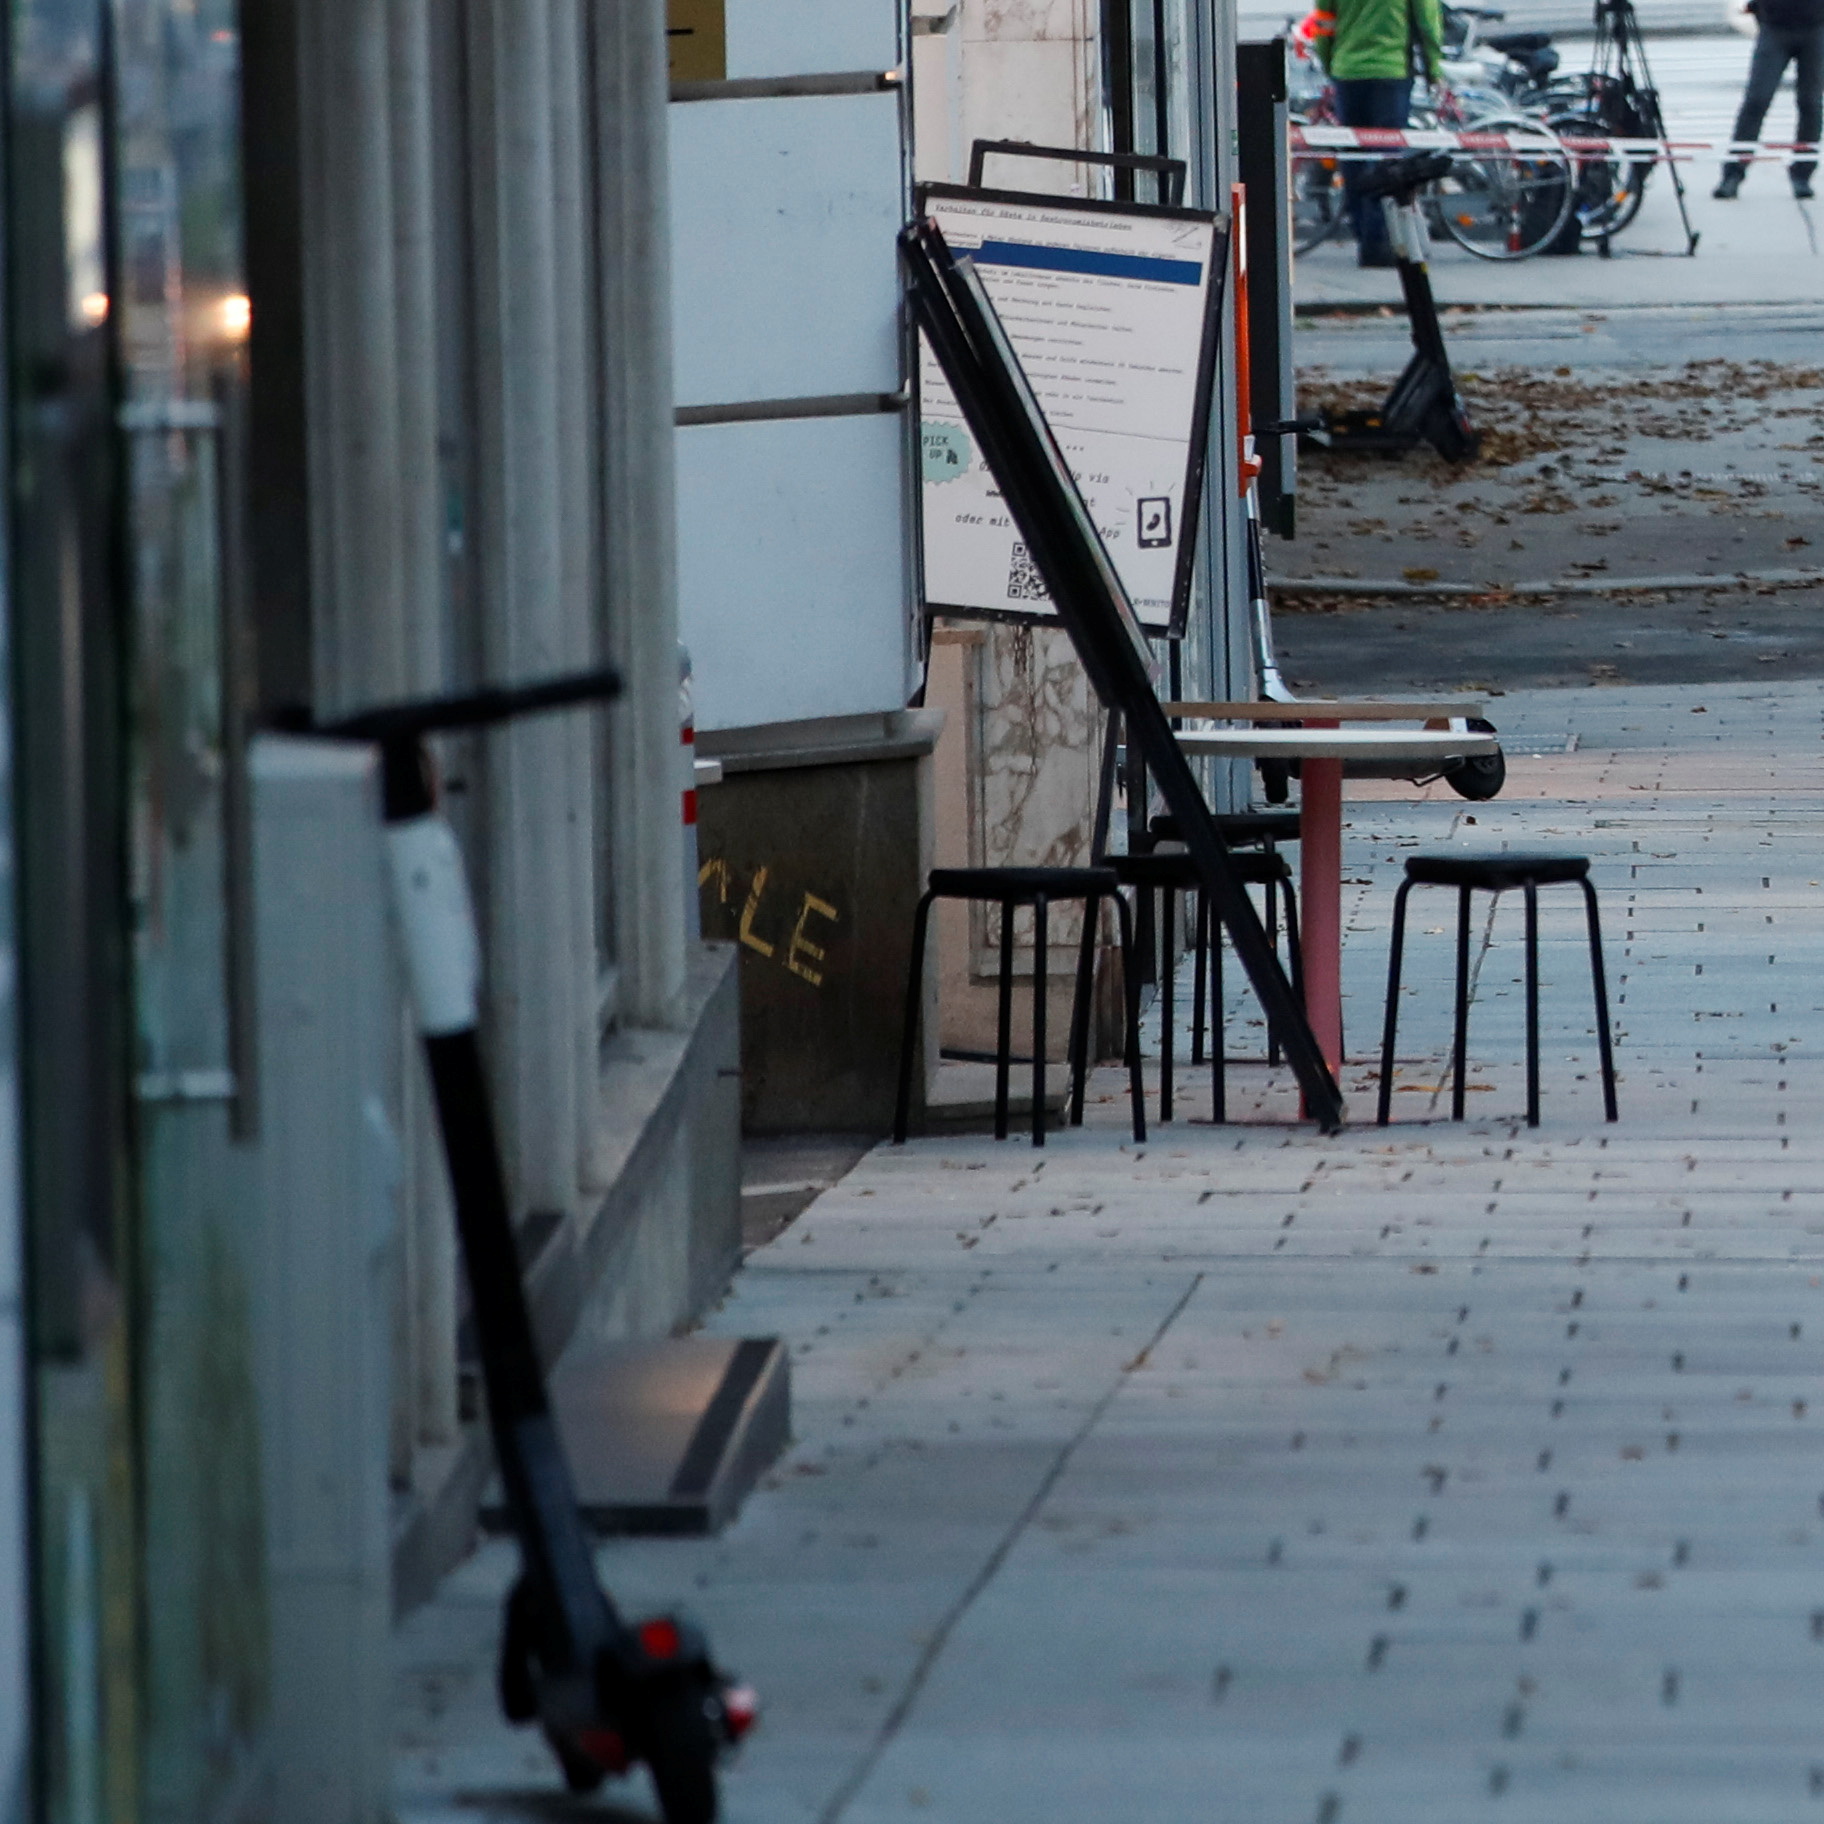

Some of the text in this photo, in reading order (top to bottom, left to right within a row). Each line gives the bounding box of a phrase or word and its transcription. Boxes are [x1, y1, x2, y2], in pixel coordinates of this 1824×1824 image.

[922, 434, 950, 447] PICK
[929, 447, 943, 460] UP
[1088, 473, 1110, 485] via
[955, 513, 1010, 528] oder mit
